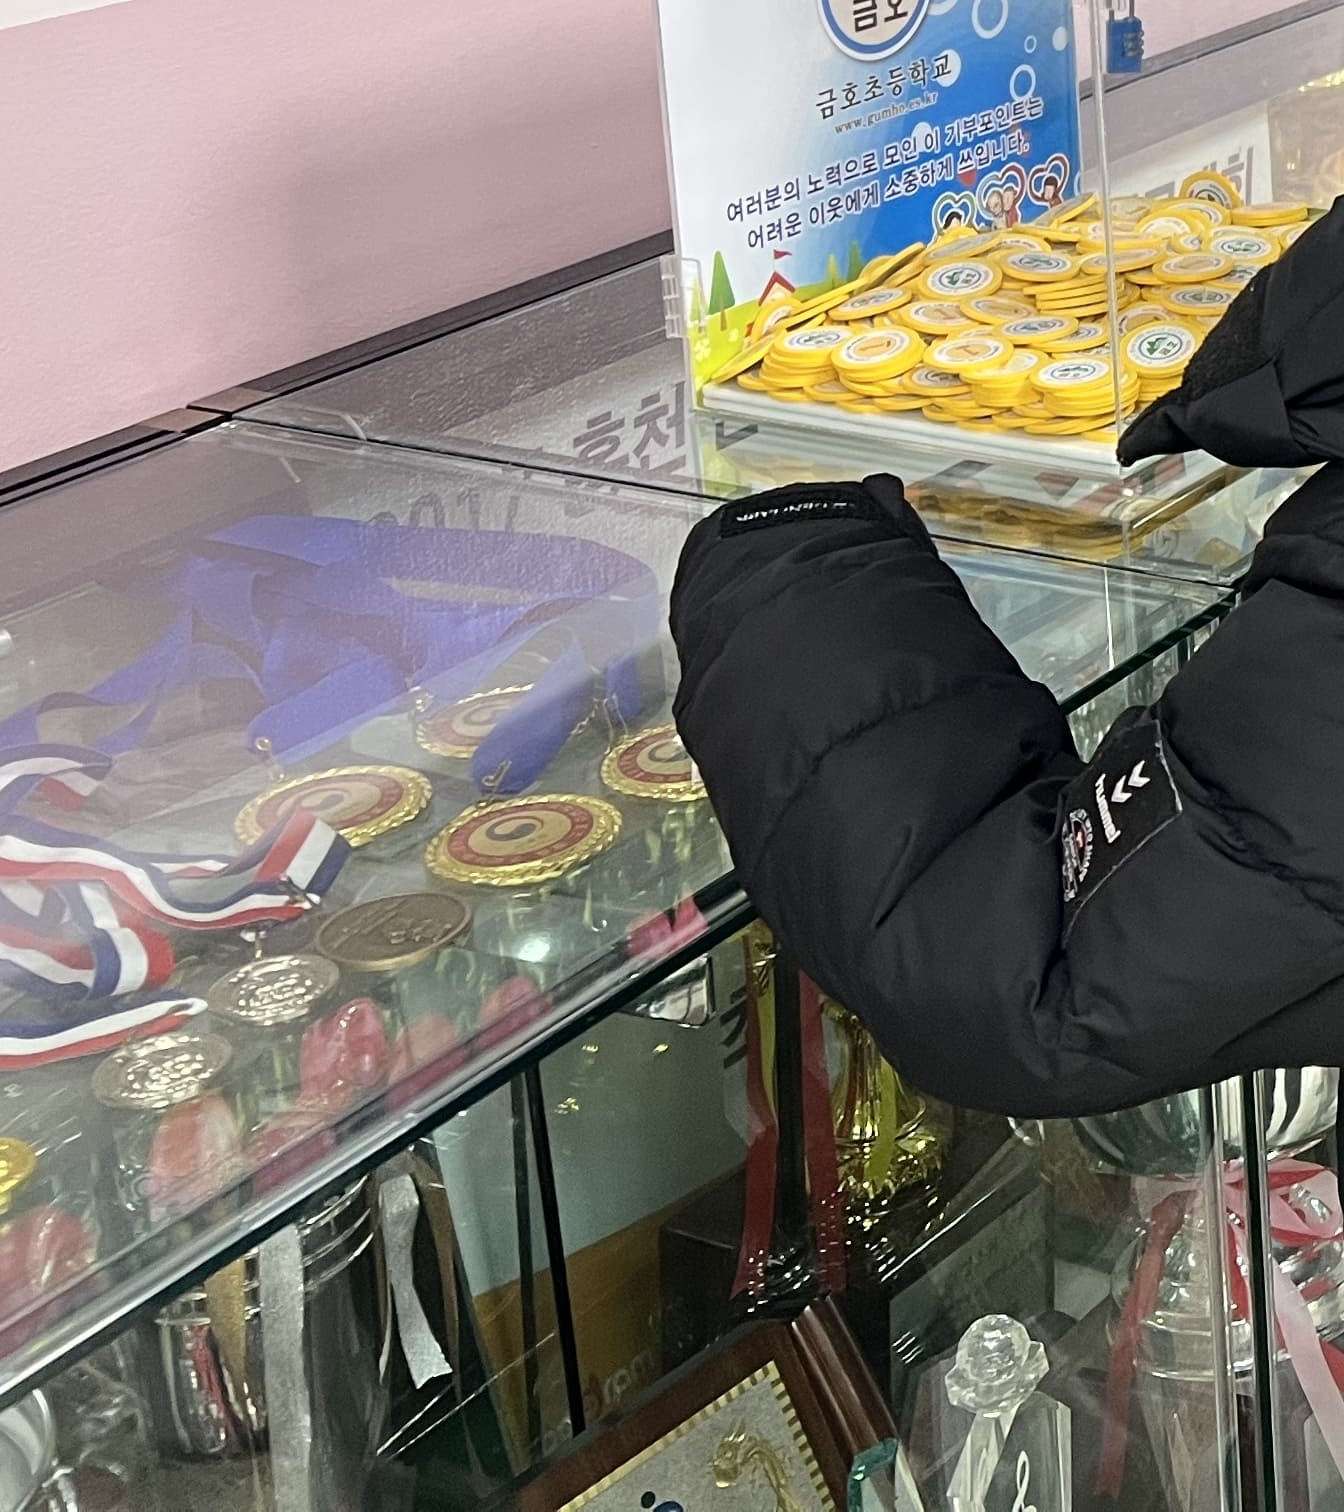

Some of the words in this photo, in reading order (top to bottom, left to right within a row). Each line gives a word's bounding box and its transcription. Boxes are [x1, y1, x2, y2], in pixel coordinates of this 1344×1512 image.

[815, 53, 953, 120] 금호초등학교
[834, 90, 939, 135] www.gumho.es.kr
[726, 177, 801, 223] 여러분의
[806, 152, 879, 195] 노력으로
[882, 138, 918, 168] 모인
[924, 132, 940, 152] 이
[944, 95, 1044, 146] 기부포인트는
[746, 211, 802, 251] 어려운
[808, 185, 879, 228] 이웃에게
[884, 159, 954, 200] 소중하게
[957, 131, 1031, 171] 쓰입니다.
[1095, 772, 1121, 844] hummel
